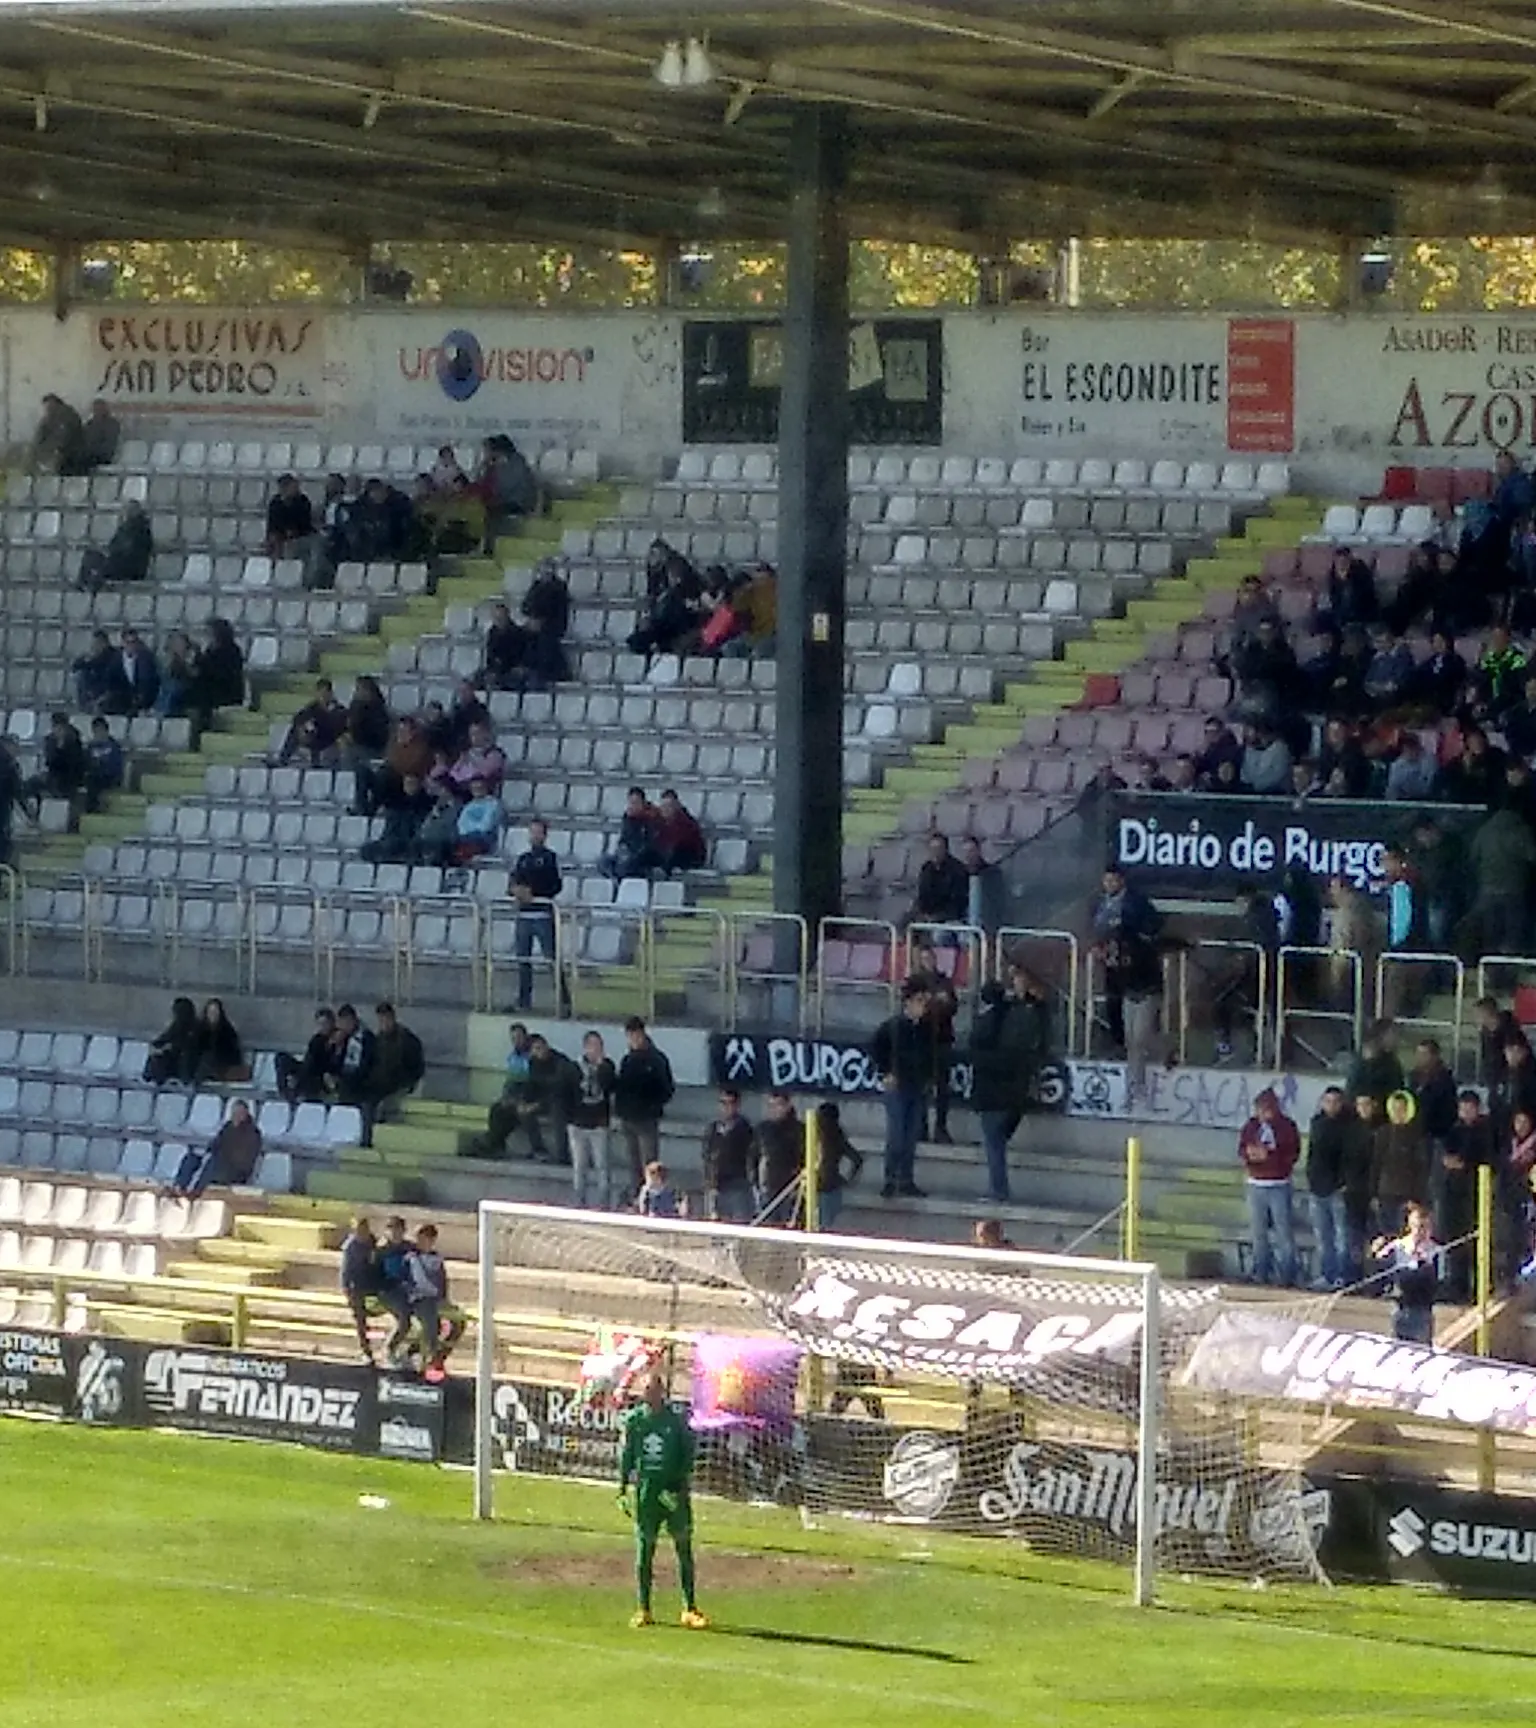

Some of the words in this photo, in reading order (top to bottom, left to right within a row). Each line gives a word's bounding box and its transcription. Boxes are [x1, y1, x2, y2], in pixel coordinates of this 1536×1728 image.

[98, 317, 313, 354] EXCLUSIVAS
[96, 359, 157, 394] SAN
[168, 360, 278, 396] PEDRO
[1023, 362, 1053, 402] EL
[1064, 360, 1221, 404] ESCONDITE
[1119, 817, 1221, 869] Diario
[1229, 820, 1276, 870] de
[1284, 827, 1390, 889] Burgo
[1126, 1066, 1252, 1126] ESACA
[174, 1371, 361, 1429] FERNANDEZ
